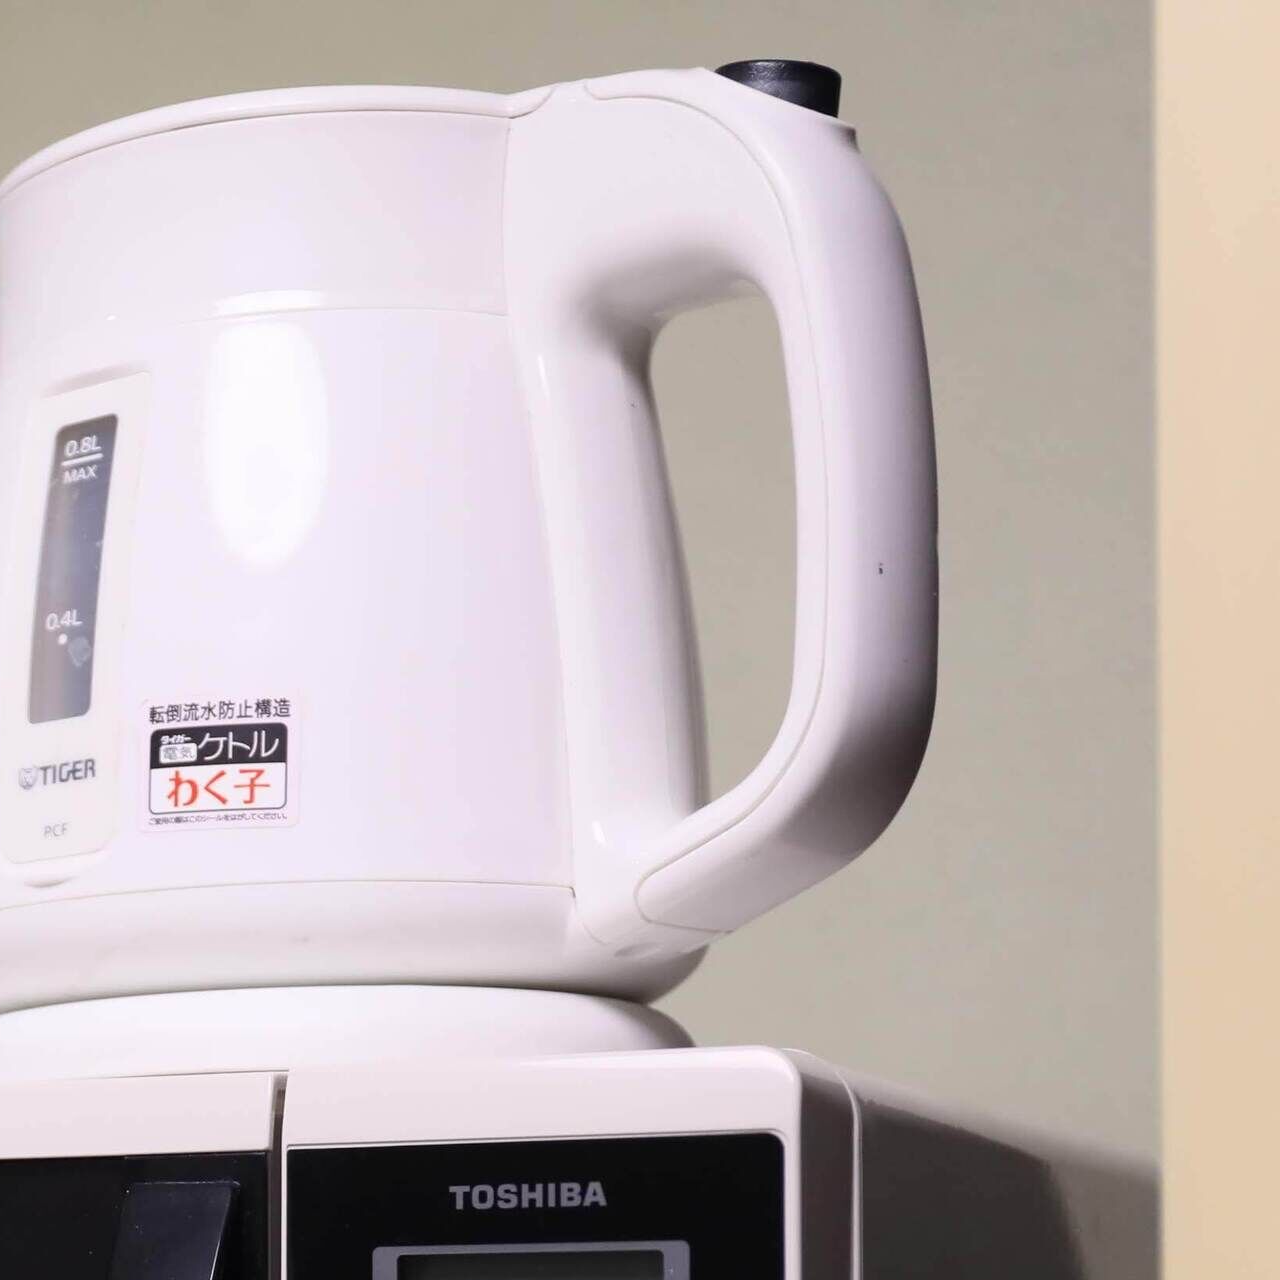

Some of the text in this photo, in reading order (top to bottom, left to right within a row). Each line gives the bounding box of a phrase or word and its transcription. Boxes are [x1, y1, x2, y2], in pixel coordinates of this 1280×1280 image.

[64, 434, 102, 457] 0.8L
[63, 464, 98, 484] MAX
[45, 609, 84, 630] 0.4L
[149, 698, 291, 725] 転倒流水防止構造
[198, 730, 280, 761] ケトル
[40, 758, 96, 786] TIGER
[167, 769, 271, 808] わく子
[448, 1181, 608, 1210] TOSHIBA
